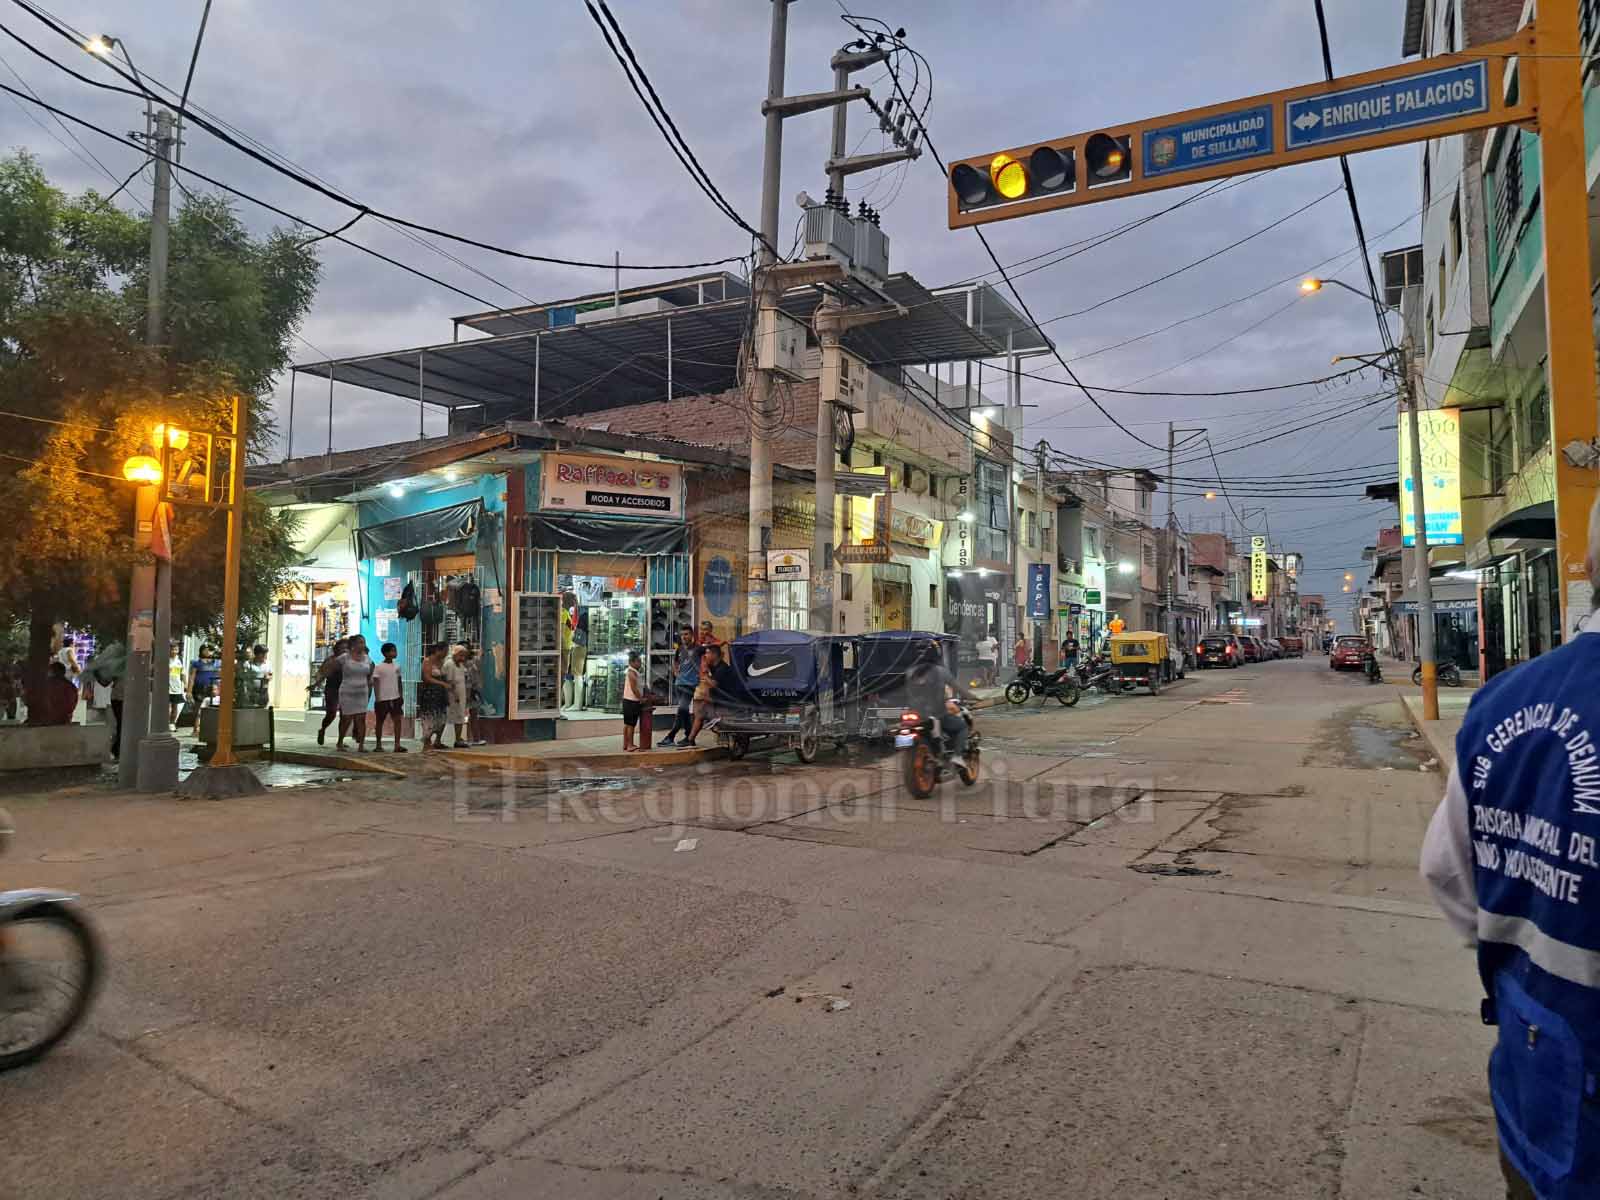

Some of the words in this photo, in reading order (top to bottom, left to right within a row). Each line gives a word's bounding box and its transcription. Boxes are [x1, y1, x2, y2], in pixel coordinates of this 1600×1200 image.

[1322, 96, 1391, 128] ENRIQUE
[1396, 78, 1475, 112] PALACIOS
[1182, 116, 1265, 144] MUNICIPALIDAD
[1192, 144, 1207, 159] DE
[1208, 135, 1257, 155] SULLANA
[590, 494, 614, 504] MODA
[615, 496, 621, 504] Y
[621, 496, 667, 508] ACCESORIOS
[1473, 755, 1493, 790] SUB
[1486, 703, 1555, 753] GERENCIA
[1551, 707, 1579, 738] DE
[1565, 729, 1600, 815] DEMUNA
[1567, 832, 1600, 869] DEL
